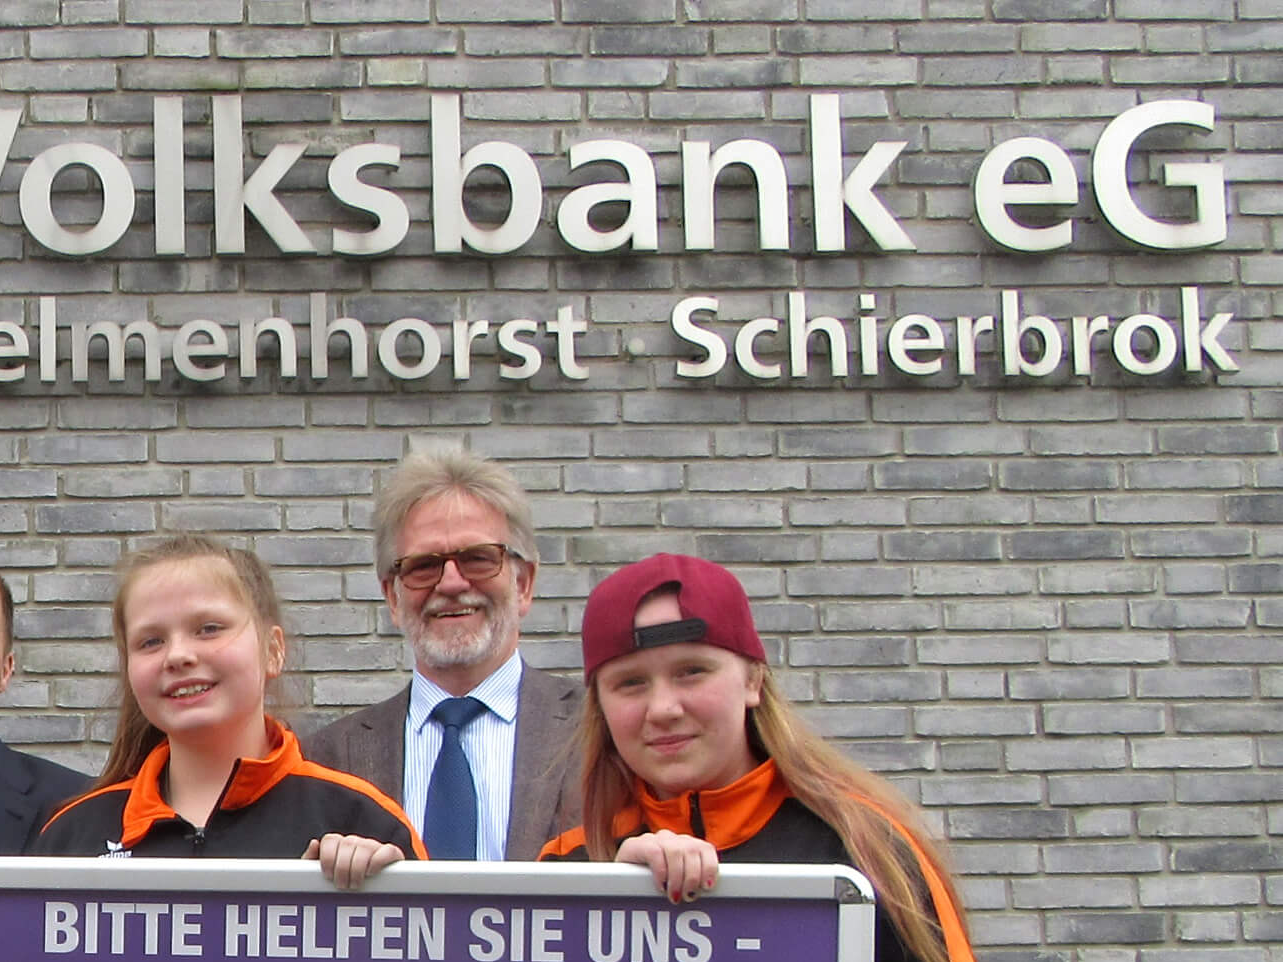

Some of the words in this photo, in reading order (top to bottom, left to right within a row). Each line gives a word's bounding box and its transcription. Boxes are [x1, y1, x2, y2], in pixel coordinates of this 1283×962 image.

[975, 99, 1229, 253] eG
[671, 287, 1241, 379] Schierbrok
[44, 901, 203, 956] BITTE
[225, 904, 446, 961] HELFEN
[468, 907, 565, 962] SIE
